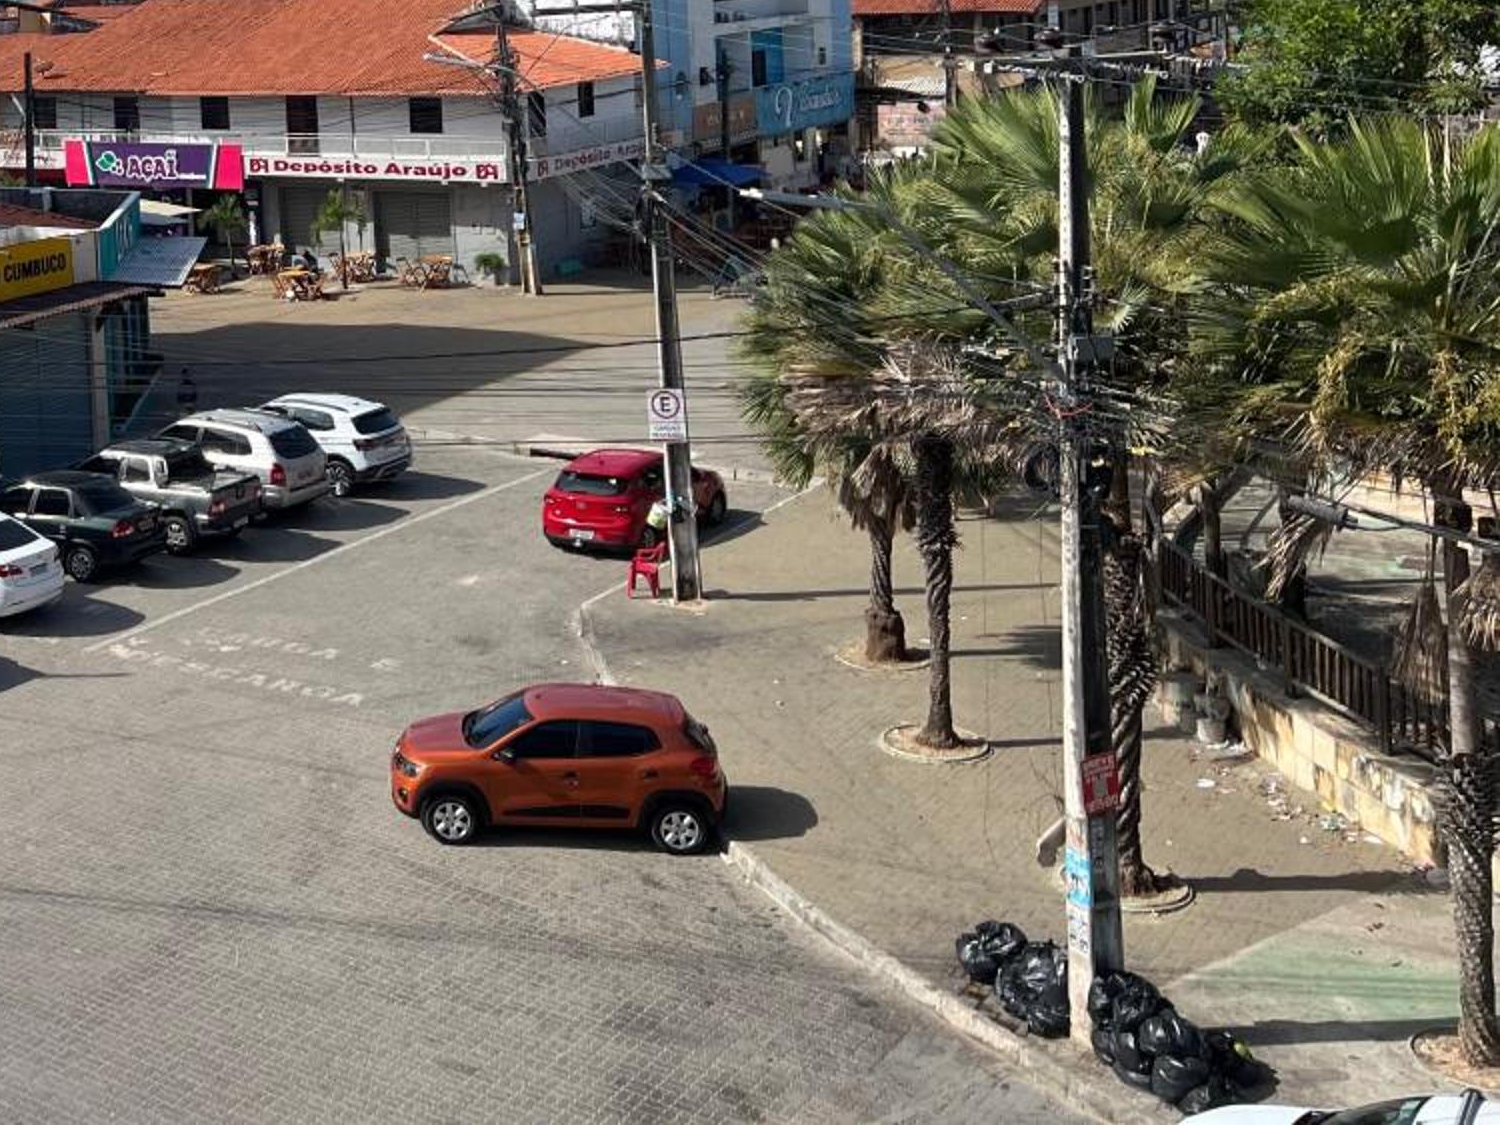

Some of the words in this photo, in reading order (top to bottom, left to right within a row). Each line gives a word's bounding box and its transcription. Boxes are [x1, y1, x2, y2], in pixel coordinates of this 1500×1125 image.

[274, 157, 378, 175] Depósito
[384, 161, 467, 181] Araújo
[3, 253, 67, 282] CUMBUCO
[660, 396, 671, 412] E
